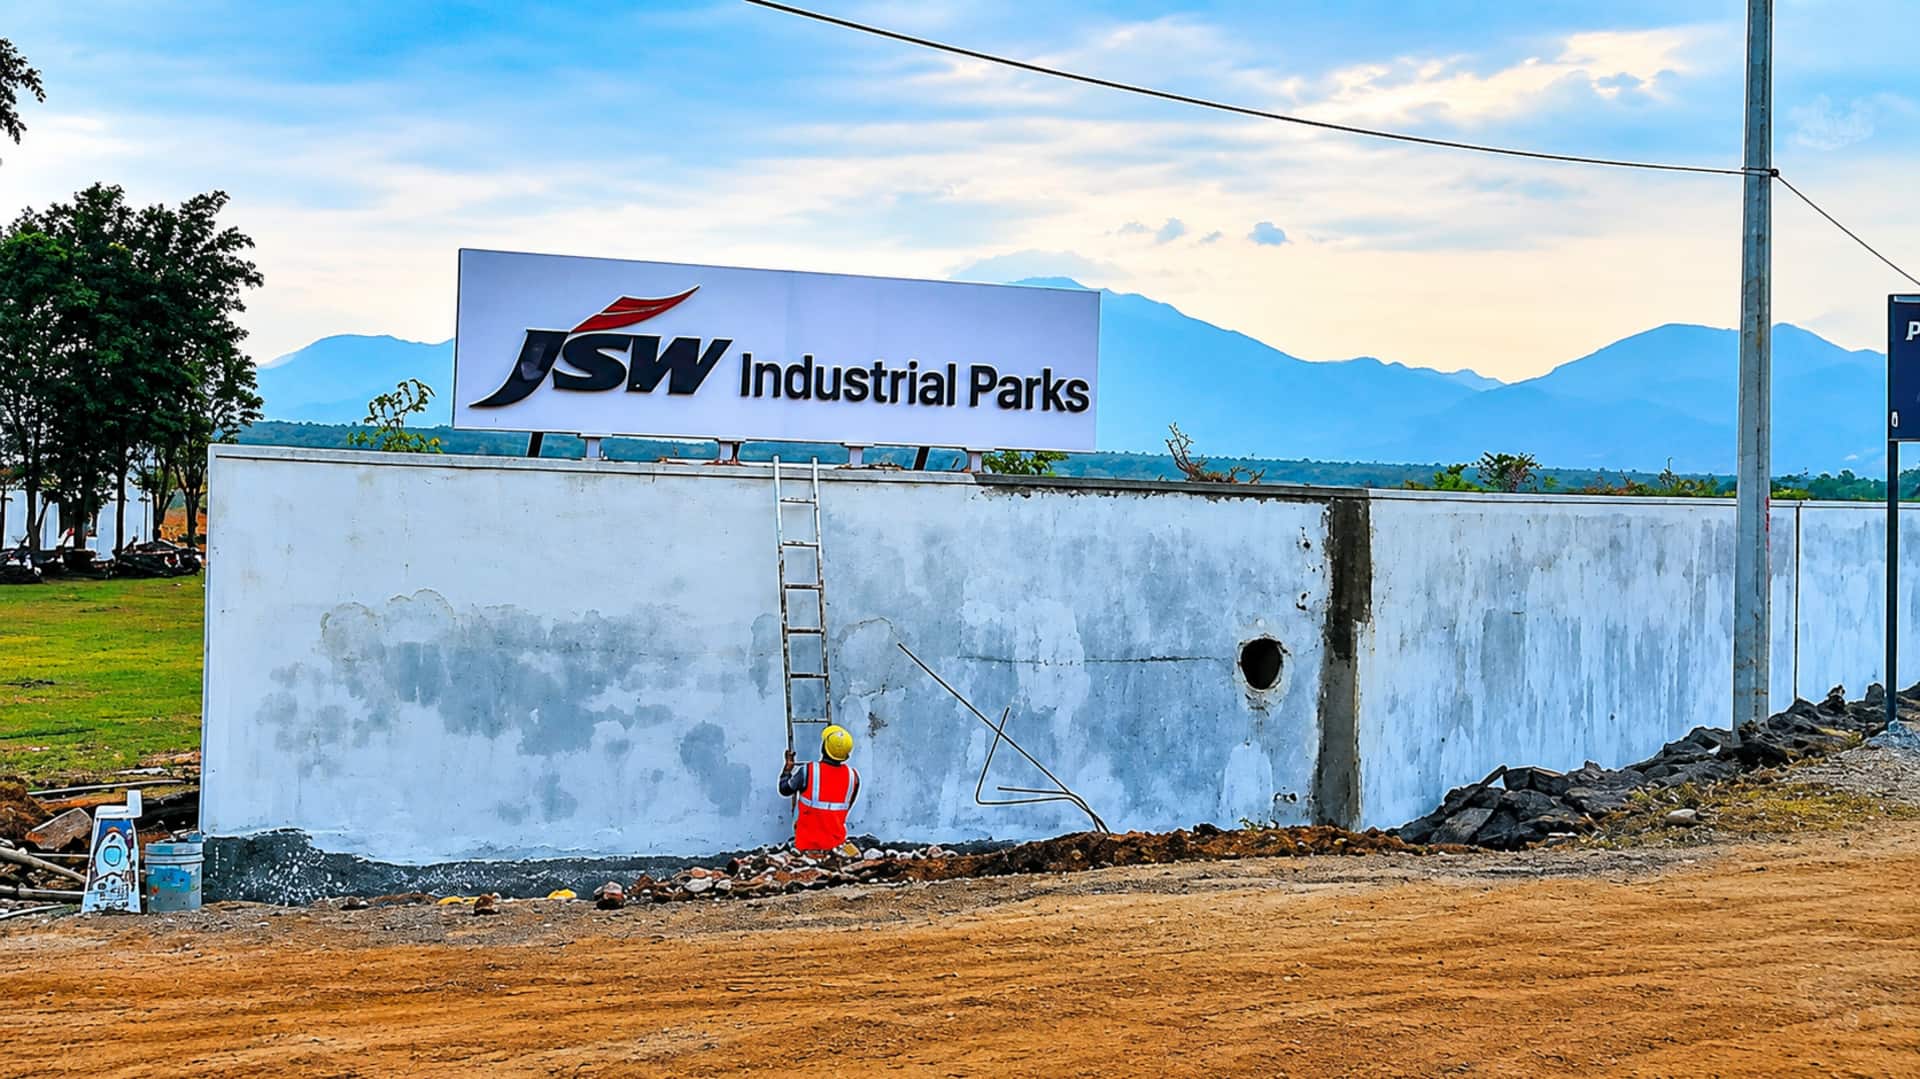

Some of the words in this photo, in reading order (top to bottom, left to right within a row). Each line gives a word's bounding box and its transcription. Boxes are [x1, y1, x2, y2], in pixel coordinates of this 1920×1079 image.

[469, 329, 733, 409] JSW
[740, 353, 956, 407] Industrial
[969, 365, 1091, 413] Parks
